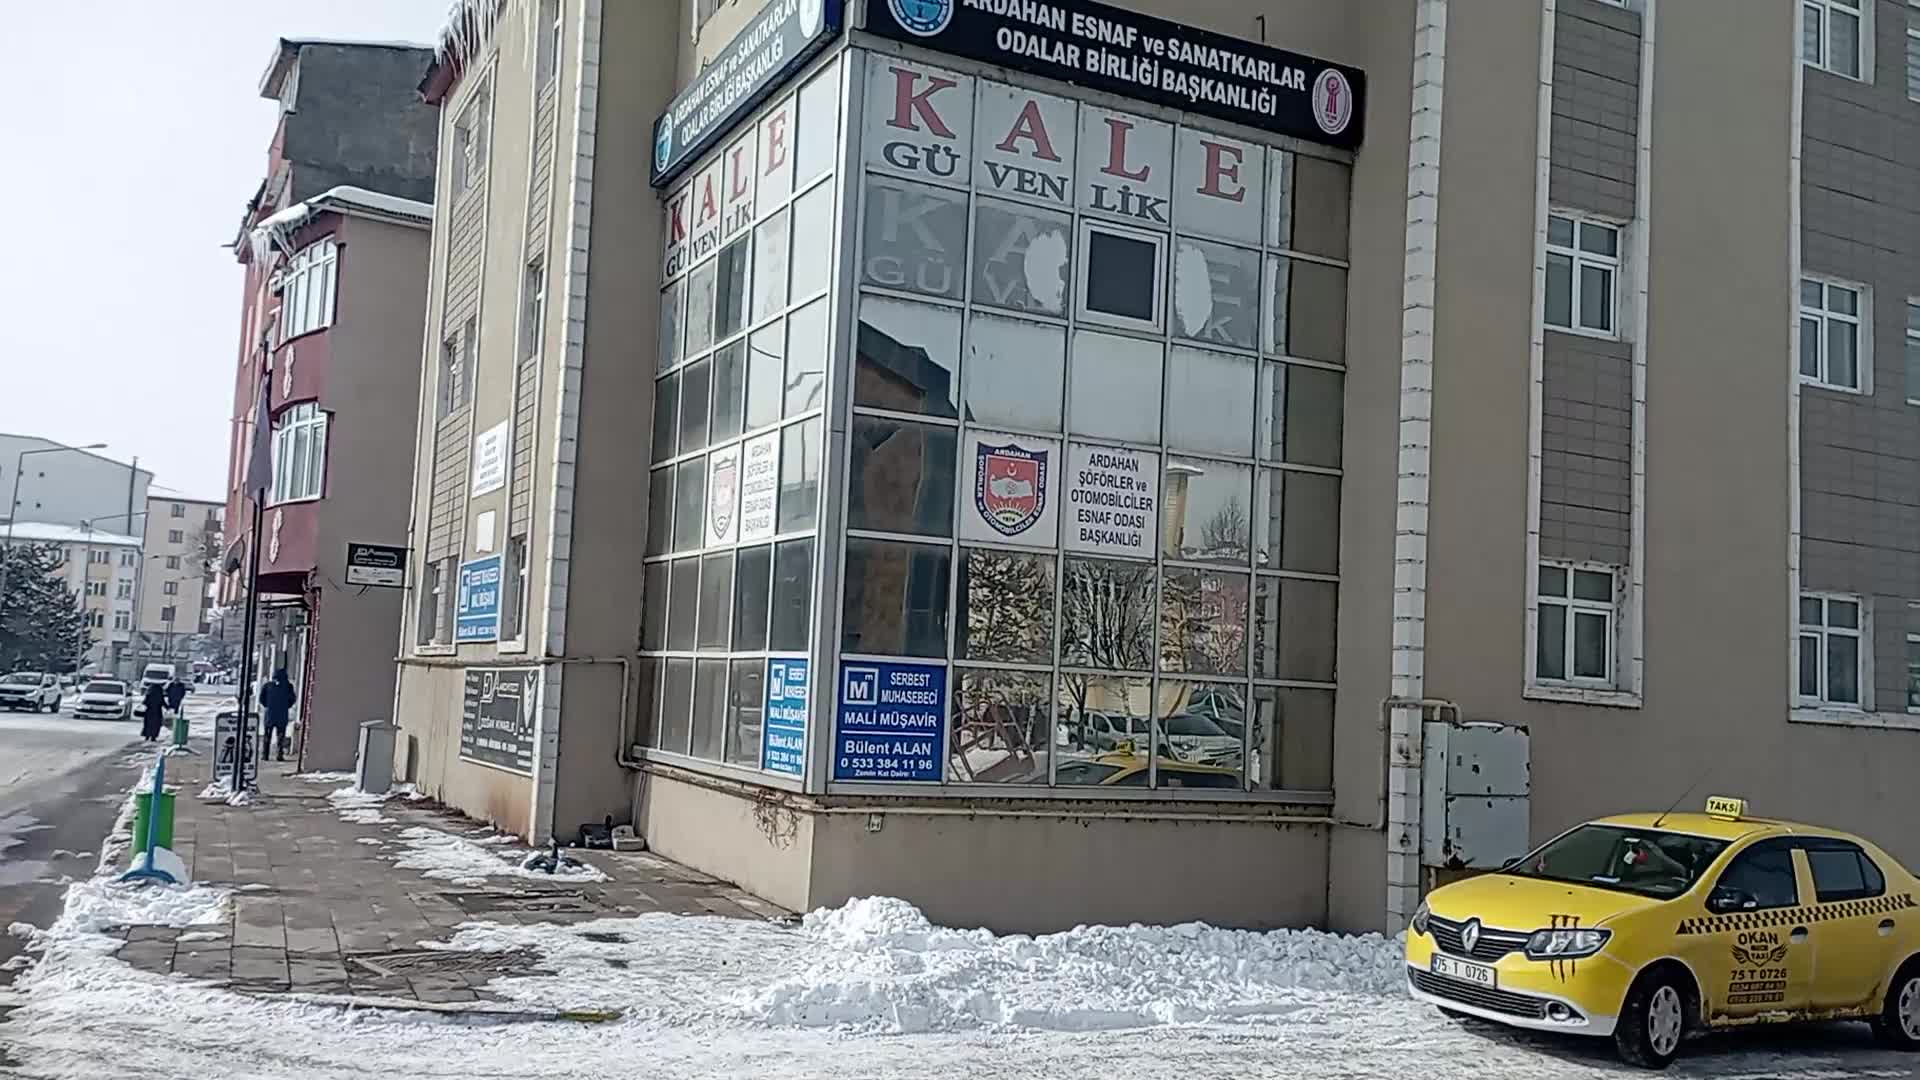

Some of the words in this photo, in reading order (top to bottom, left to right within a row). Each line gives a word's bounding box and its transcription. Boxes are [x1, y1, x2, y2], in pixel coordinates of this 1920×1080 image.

[1072, 13, 1139, 48] ESNAF
[1143, 36, 1165, 56] ve
[1167, 38, 1306, 91] SANATKARLAR
[997, 27, 1080, 69] ODALAR
[1086, 47, 1159, 88] BİRLİĞİ
[1162, 67, 1277, 116] BAŞKANLIĞI
[1089, 453, 1139, 472] ARDAHAN
[1079, 468, 1134, 490] ŞÖFÖRLER
[1136, 481, 1147, 492] ve
[1071, 488, 1153, 511] OTOMOBİLCİLER
[1078, 508, 1112, 525] ESNAF
[1114, 513, 1145, 529] ODASI
[1080, 528, 1142, 547] BAŞKANLIĞI
[890, 672, 931, 687] SERBEST
[881, 689, 938, 705] MUHASEBECİ
[844, 709, 877, 725] MALİ
[880, 711, 937, 729] MÜŞAVİR
[845, 740, 890, 755] Bülent
[892, 742, 932, 756] ALAN
[841, 758, 849, 768] 0
[852, 758, 874, 768] 533
[877, 758, 898, 769] 384
[902, 759, 914, 769] 11
[918, 760, 933, 770] 96
[1738, 932, 1779, 945] OKAN
[1437, 957, 1448, 972] 75
[1454, 962, 1458, 974] T
[1465, 965, 1488, 982] 0726
[1731, 970, 1745, 981] 75
[1748, 969, 1756, 979] T
[1760, 968, 1787, 979] 0726
